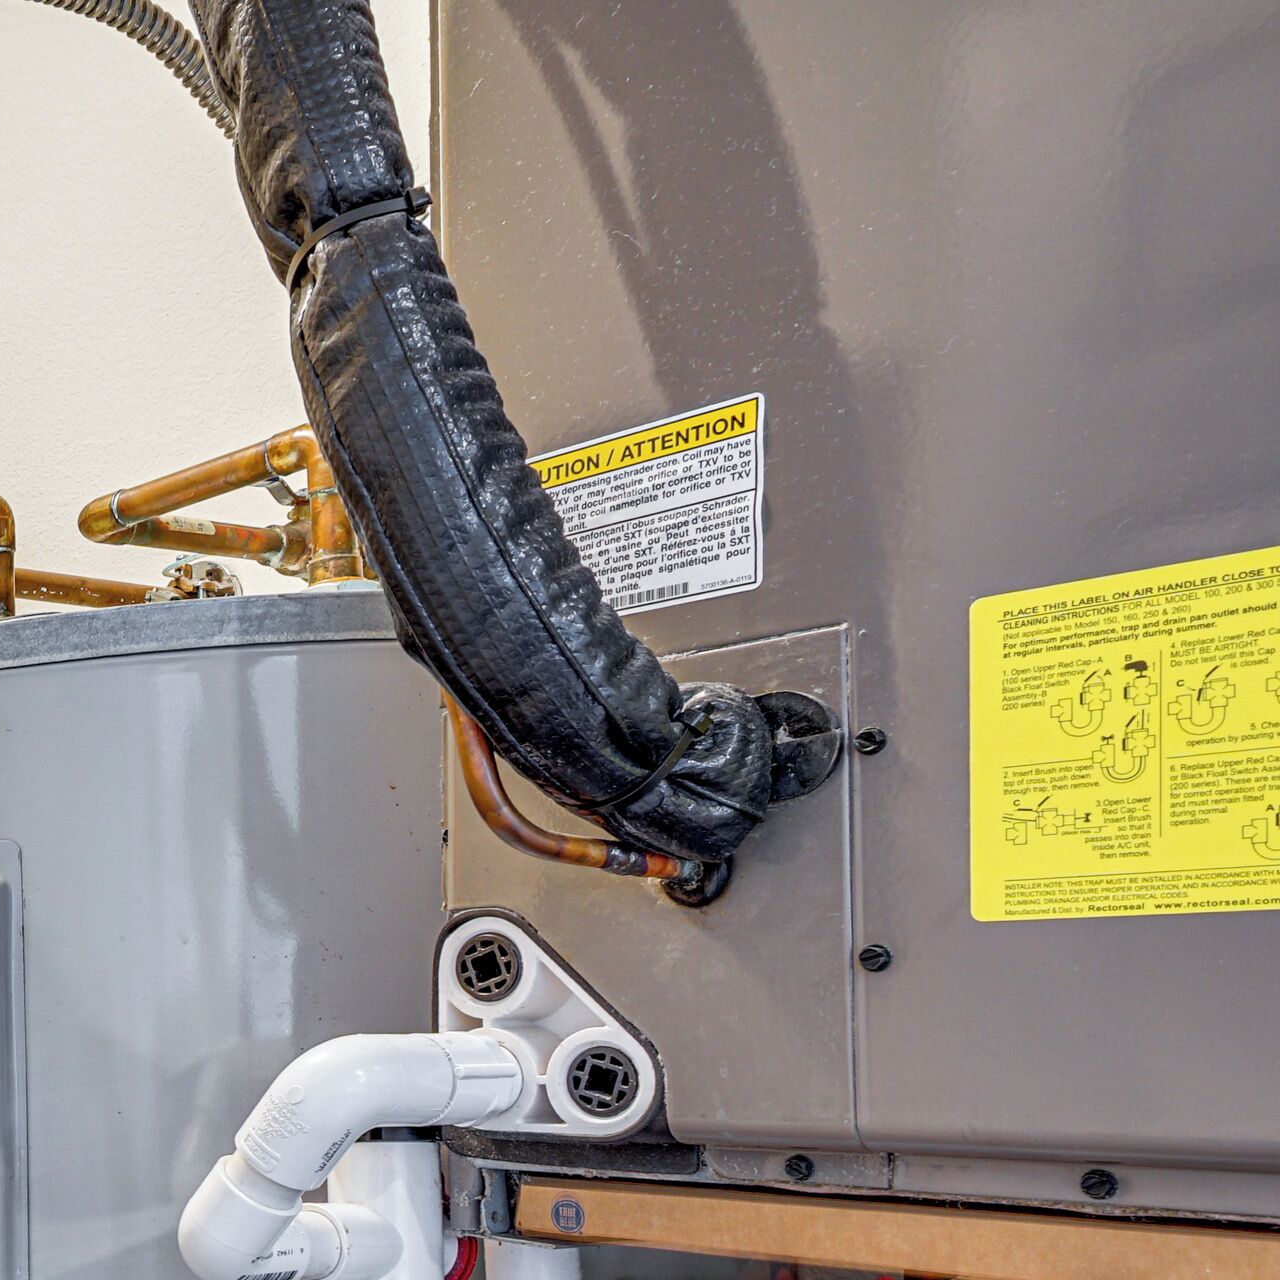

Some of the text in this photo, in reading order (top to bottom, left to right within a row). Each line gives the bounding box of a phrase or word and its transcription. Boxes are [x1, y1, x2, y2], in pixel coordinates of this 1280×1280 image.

[539, 411, 746, 485] UTION ATTENTION
[561, 476, 611, 495] depressing
[613, 463, 654, 482] schrader
[703, 444, 725, 458] may
[727, 437, 752, 451] have
[581, 486, 650, 510] documentation
[652, 482, 666, 492] for
[668, 472, 703, 488] correct
[705, 464, 739, 478] orifice
[587, 448, 752, 499] may require orifice TXV be
[609, 494, 659, 513] nameplate
[662, 489, 676, 499] for
[679, 480, 711, 494] orifice
[730, 468, 752, 482] TXV
[1003, 568, 1265, 618] PLACE THIS LABEL ON AIR HANDLER CLOSE
[1003, 616, 1049, 631] CLEANING
[1050, 604, 1120, 623] INSTRUCTIONS
[1003, 642, 1017, 651] For
[1019, 637, 1057, 650] optimum
[1142, 620, 1160, 630] and
[1162, 615, 1187, 627] drain
[1189, 614, 1208, 624] pan
[1210, 607, 1240, 619] outlet
[1241, 602, 1277, 615] should
[1142, 626, 1173, 639] during
[1087, 902, 1145, 914] Rectorseal
